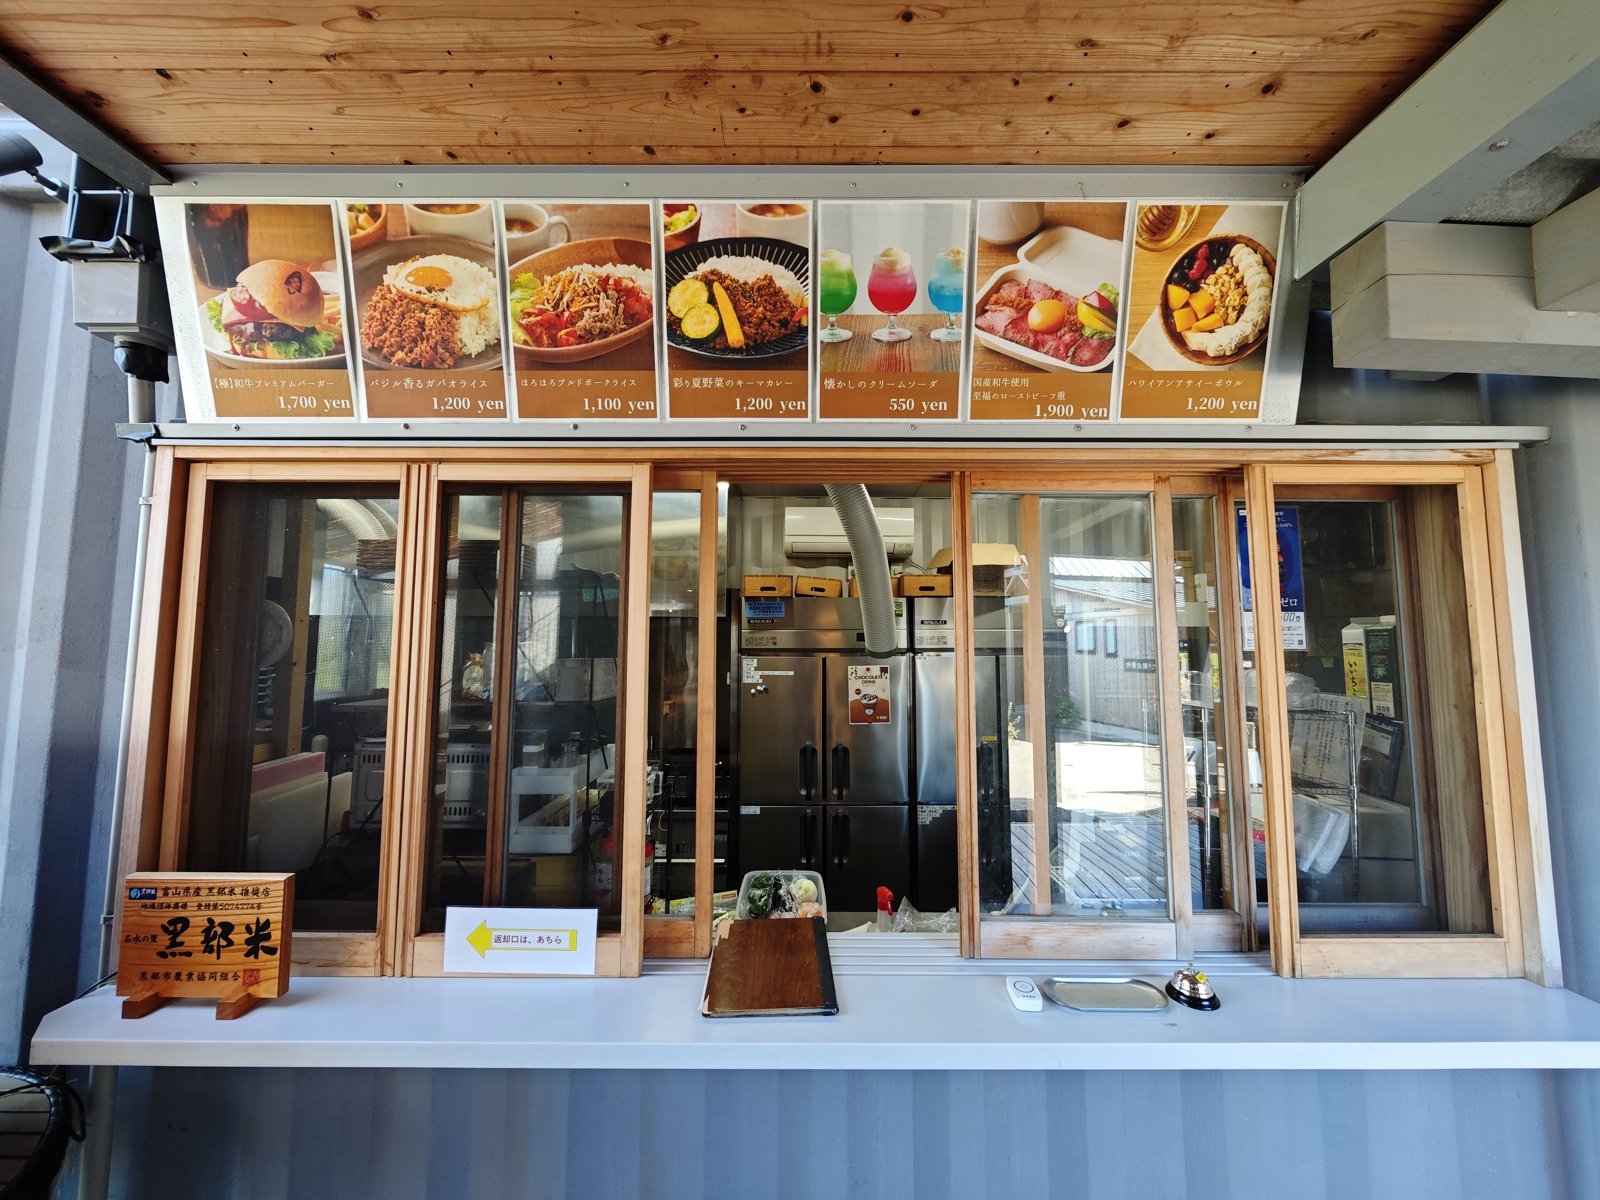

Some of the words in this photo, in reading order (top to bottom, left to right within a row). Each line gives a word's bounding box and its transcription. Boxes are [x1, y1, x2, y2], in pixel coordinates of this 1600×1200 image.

[672, 377, 793, 388] 彩り夏野菜のキーマカレー
[823, 378, 938, 390] 懐かしのクリームソーダ
[973, 377, 1029, 387] 国産和牛使用
[1127, 379, 1243, 388] ハワイアンアサイーボウル
[278, 396, 317, 411] 1,700
[323, 399, 350, 412] yen
[972, 391, 1066, 401] 至福のローストビーフ重
[432, 397, 471, 412] 1,200
[477, 400, 504, 413] yen
[583, 398, 621, 413] 1,100
[628, 400, 655, 414] yen
[734, 397, 773, 412] 1,200
[779, 400, 806, 414] yen
[889, 398, 915, 411] 550
[921, 401, 948, 414] yen
[1034, 404, 1074, 420] 1,900
[1081, 407, 1108, 420] yen
[1186, 397, 1225, 413] 1,200
[1230, 400, 1257, 413] yen
[162, 886, 202, 897] 富山県産
[156, 916, 278, 960] 黒部米
[493, 934, 562, 945] 返却口は、あちら
